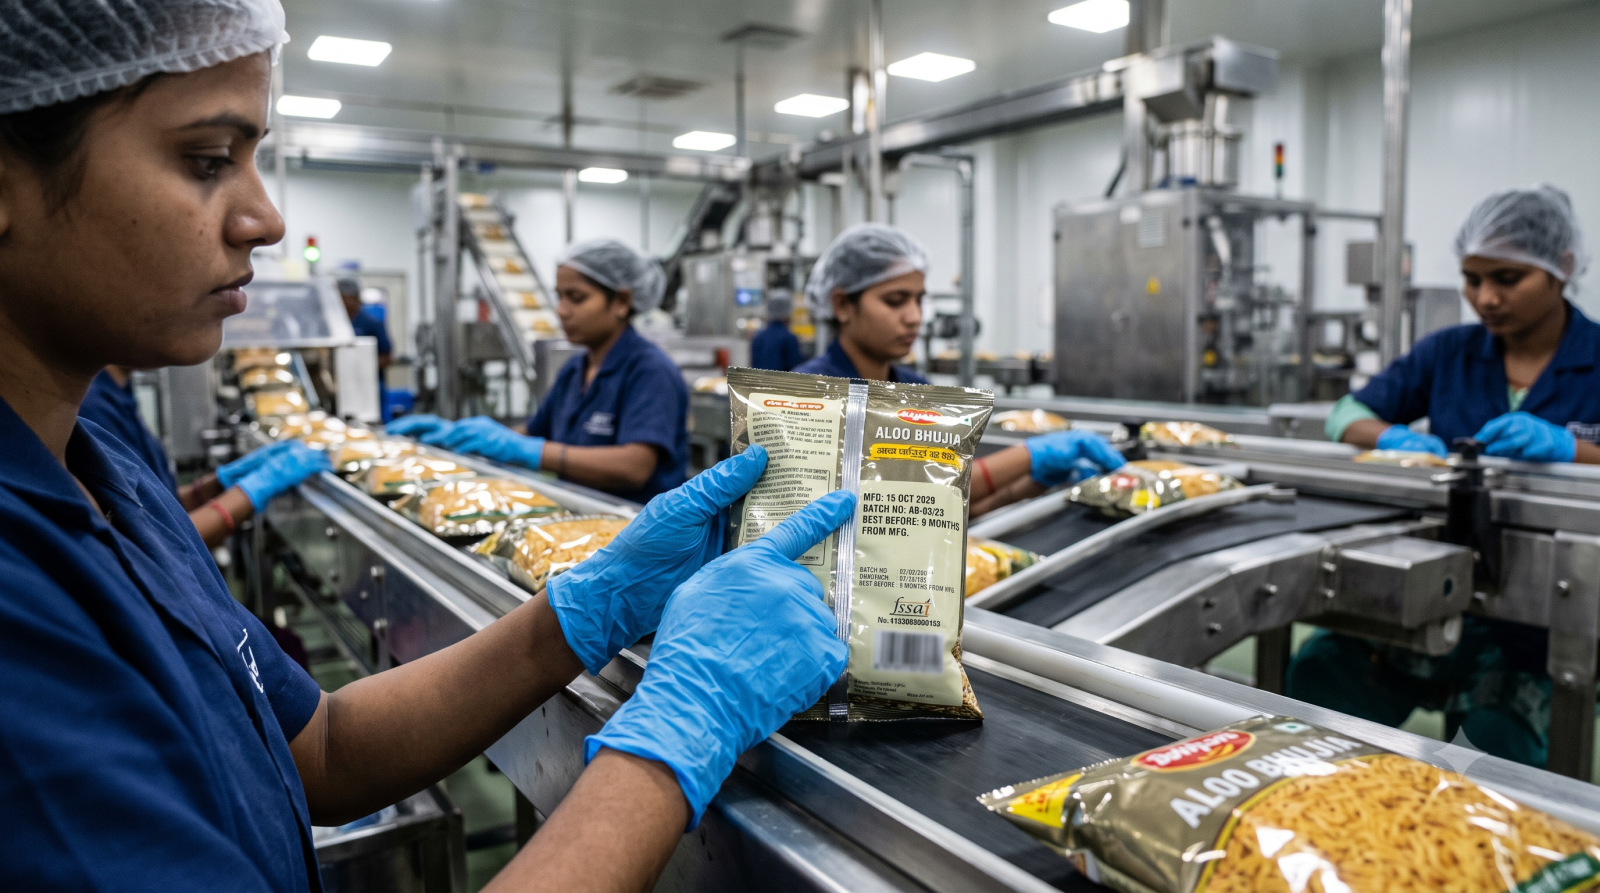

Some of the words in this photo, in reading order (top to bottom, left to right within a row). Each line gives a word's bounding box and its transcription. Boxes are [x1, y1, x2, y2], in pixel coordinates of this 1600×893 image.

[875, 426, 911, 440] ALOO
[914, 429, 961, 446] BHUJIA
[863, 493, 883, 502] MFD:
[886, 494, 895, 502] 15
[898, 494, 914, 503] OCT
[916, 495, 935, 504] 2029
[863, 504, 889, 513] BATCH
[892, 506, 906, 514] NO:
[909, 506, 944, 516] AB-03/23
[863, 516, 883, 524] BEST
[886, 516, 919, 526] BEFORE:
[922, 518, 926, 526] 9
[929, 519, 960, 531] MONTHS
[862, 527, 886, 535] FROM
[888, 528, 909, 537] MFG.
[1170, 769, 1261, 829] ALOO
[1245, 735, 1362, 777] BHUJIA
